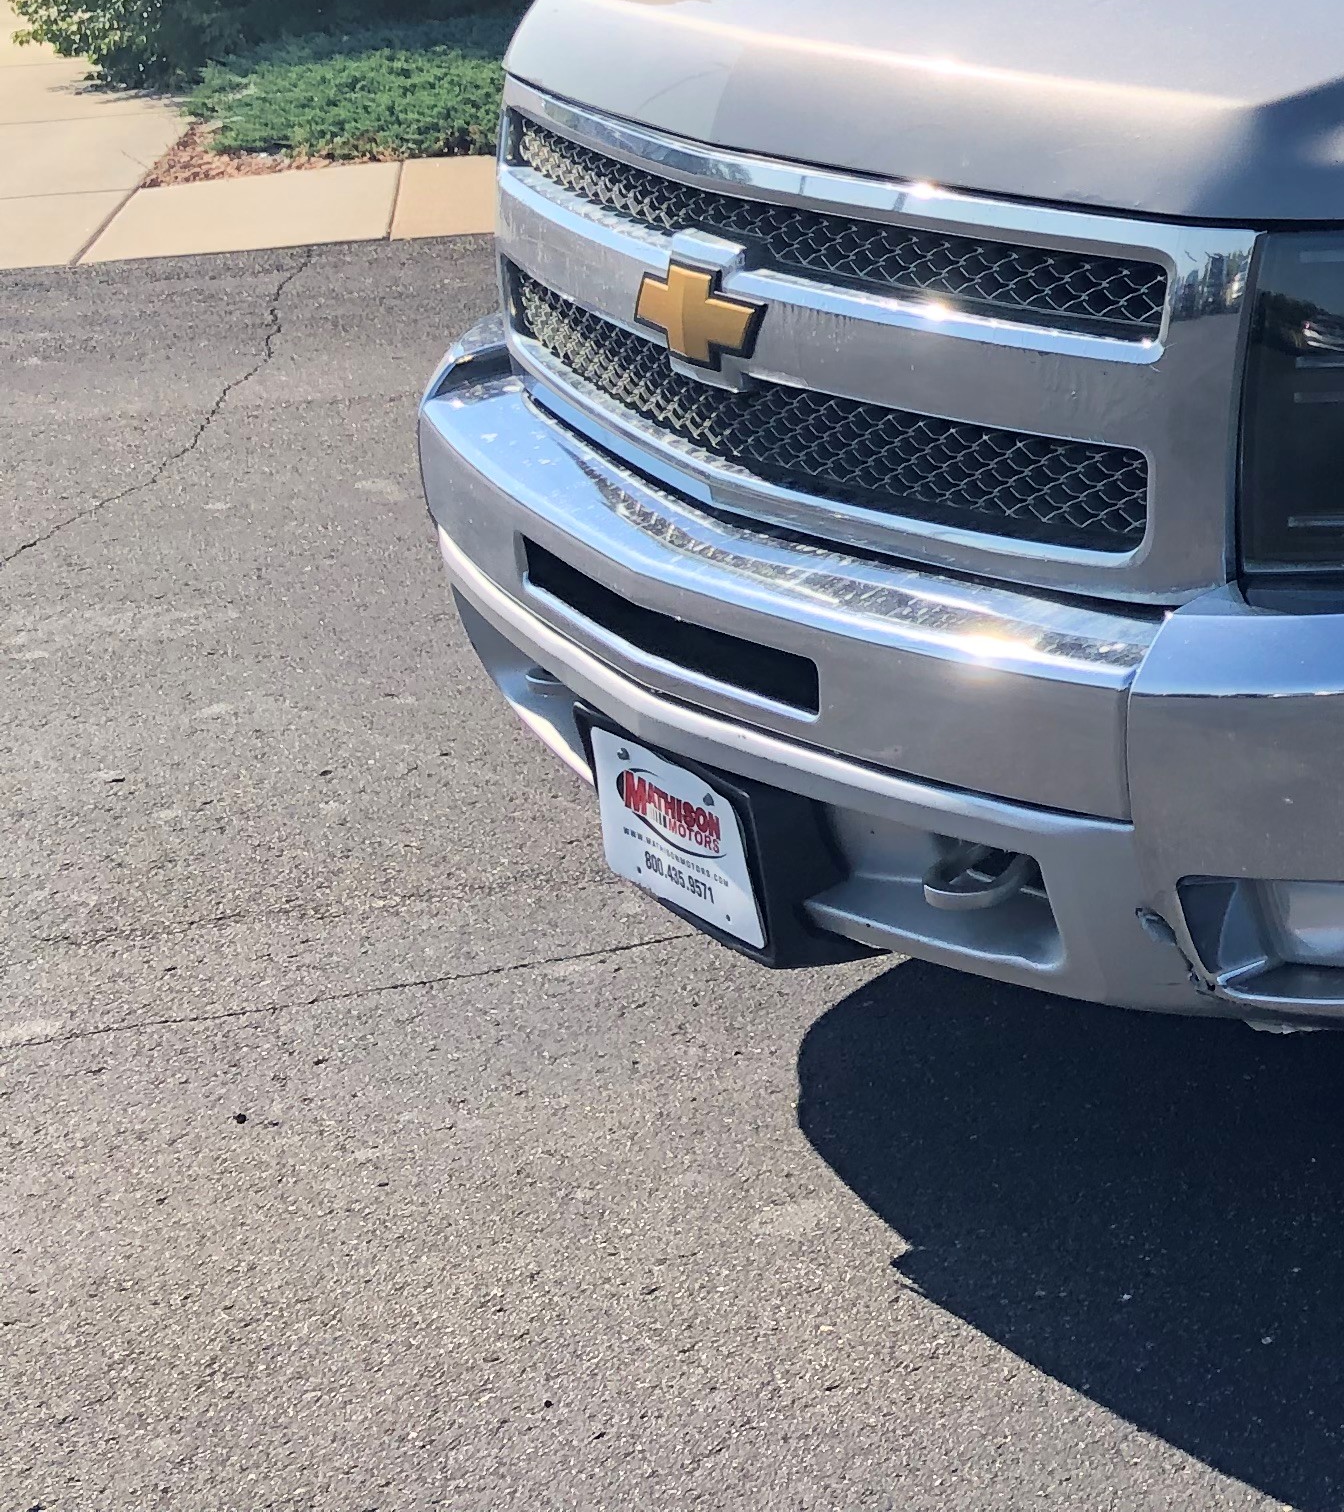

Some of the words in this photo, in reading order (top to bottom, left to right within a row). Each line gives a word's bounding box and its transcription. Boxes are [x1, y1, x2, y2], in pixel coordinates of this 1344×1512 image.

[624, 770, 721, 841] MATHISON
[668, 816, 720, 854] MOTORS
[644, 850, 715, 904] 800.435.9571
